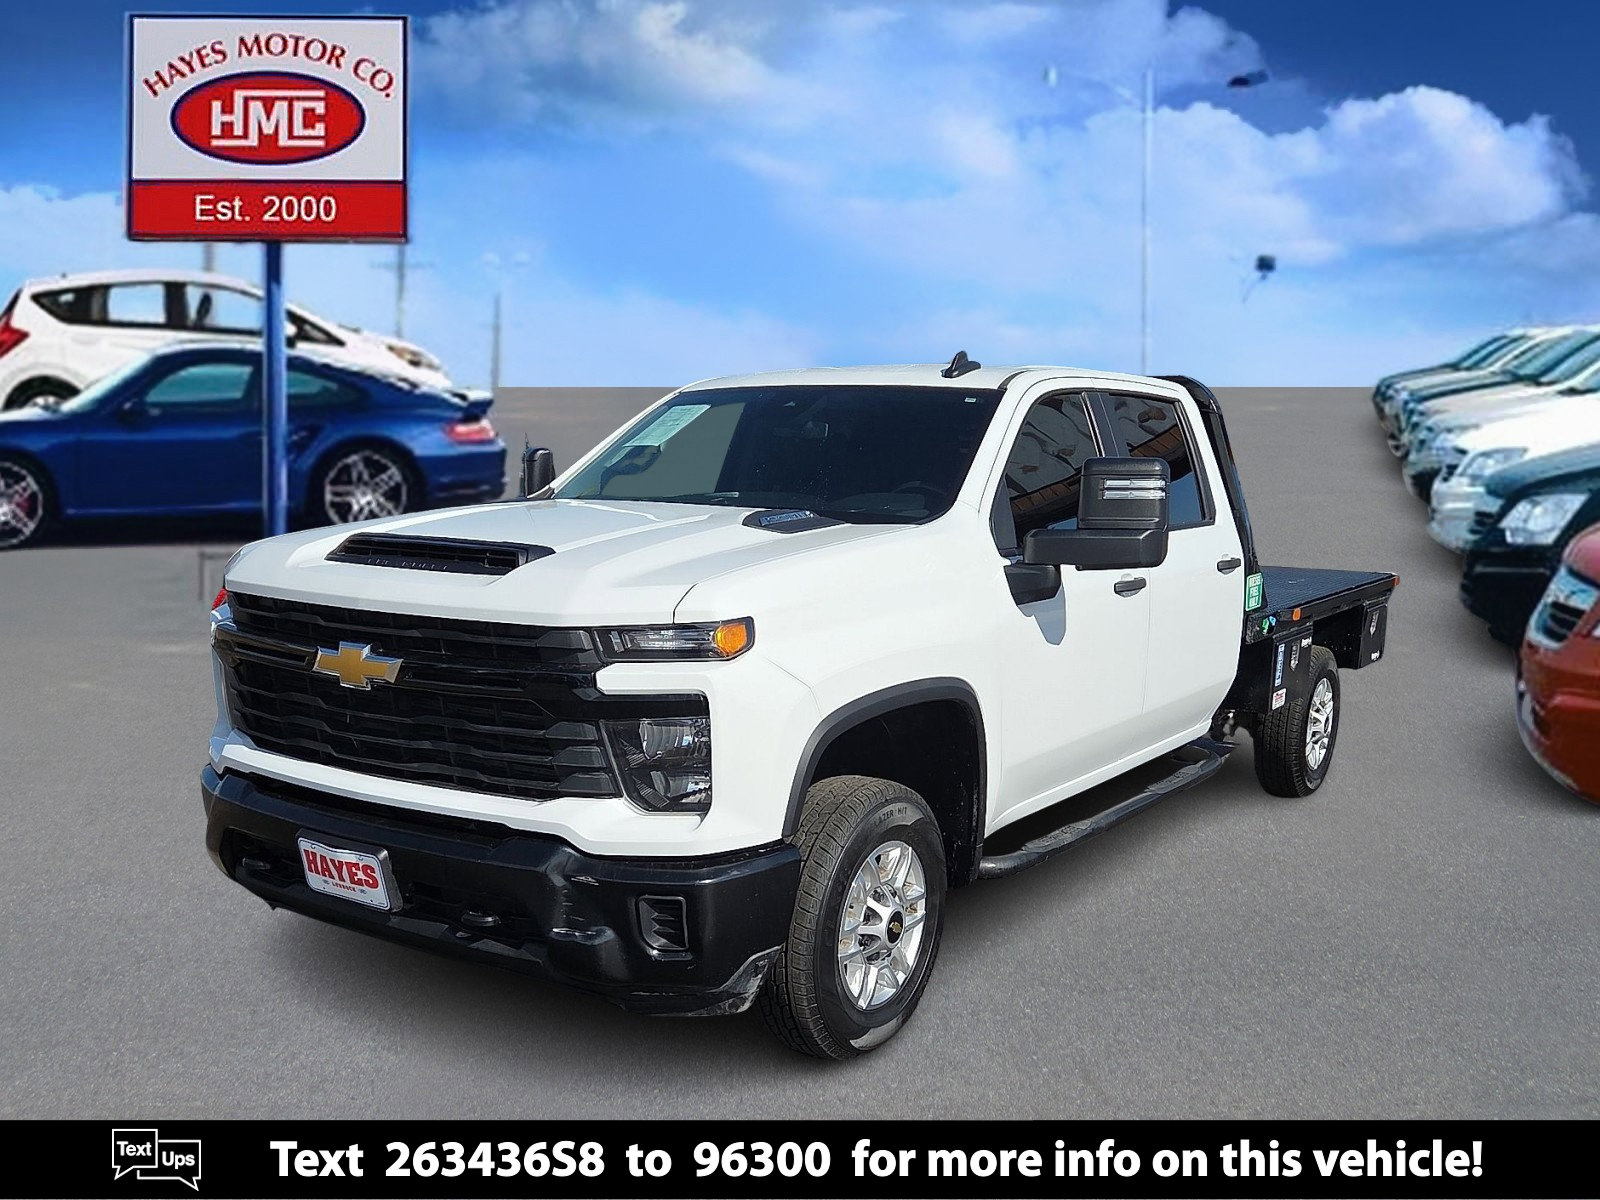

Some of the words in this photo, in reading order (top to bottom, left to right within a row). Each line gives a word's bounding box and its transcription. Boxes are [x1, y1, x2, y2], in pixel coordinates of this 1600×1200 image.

[143, 40, 228, 98] HAYES
[237, 32, 347, 70] MOTOR
[352, 57, 395, 99] CO.
[210, 88, 326, 147] HMC
[194, 194, 251, 222] Est.
[262, 195, 337, 223] 2000
[303, 848, 380, 890] HAYES
